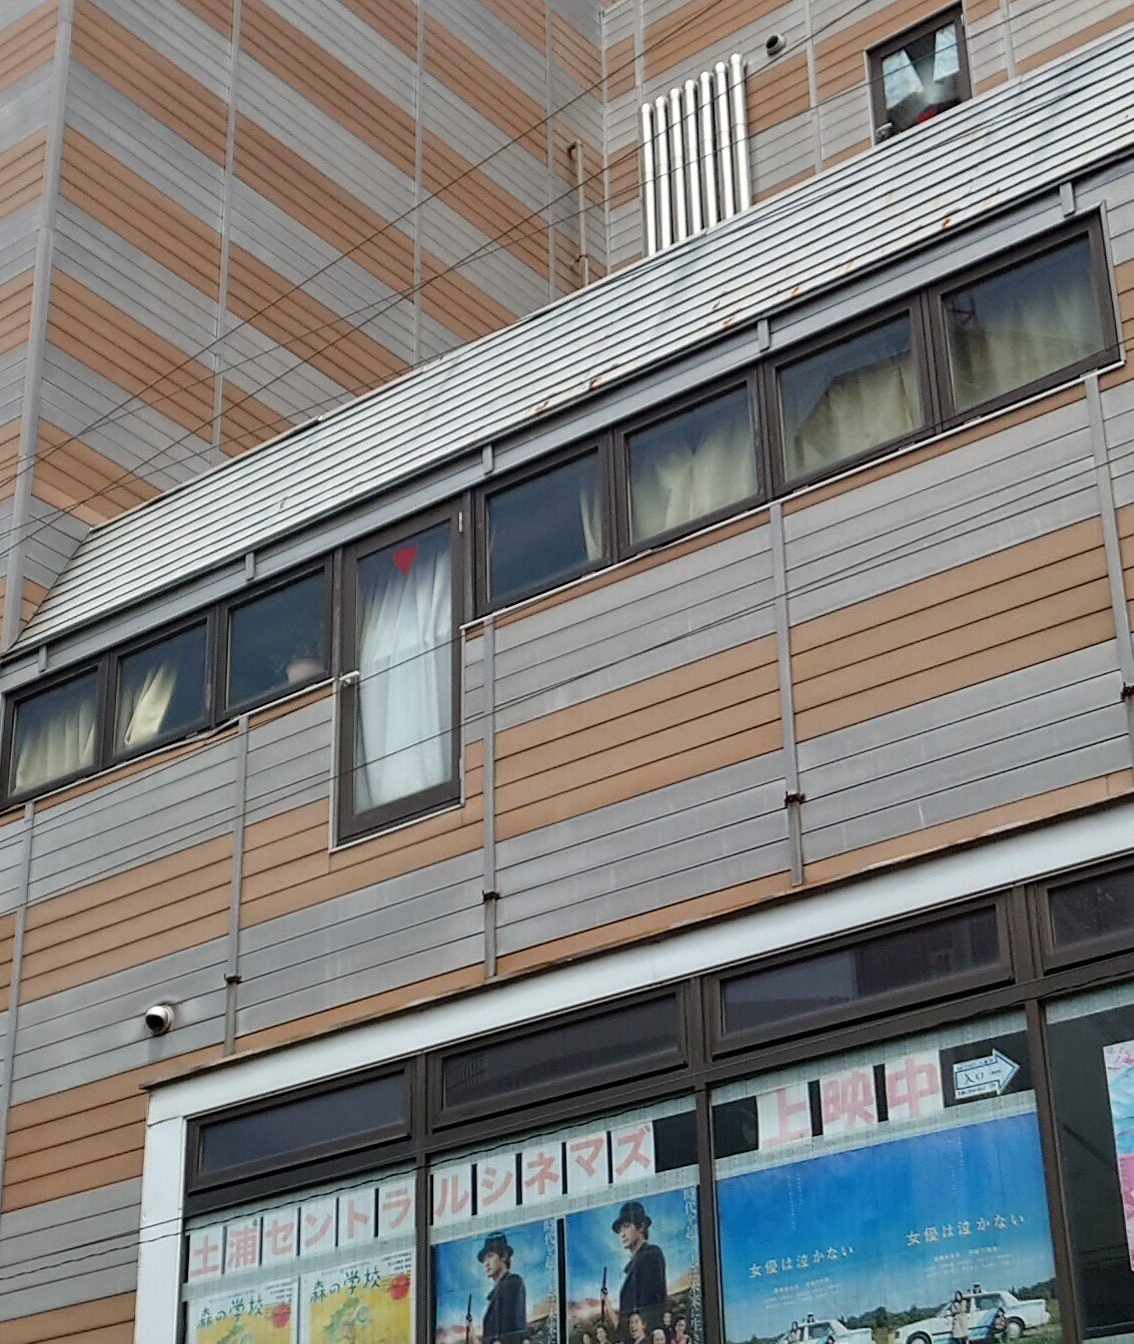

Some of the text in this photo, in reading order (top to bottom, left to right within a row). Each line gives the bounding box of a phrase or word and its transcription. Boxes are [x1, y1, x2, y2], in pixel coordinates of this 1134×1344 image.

[761, 1057, 940, 1148] 上映中
[189, 1126, 653, 1278] 土浦セントラルシネマズ
[906, 1213, 1026, 1247] 女優は泣かない
[748, 1245, 854, 1279] 女優は泣かない
[310, 1266, 381, 1302] 森の学校
[197, 1295, 263, 1329] 森の学校
